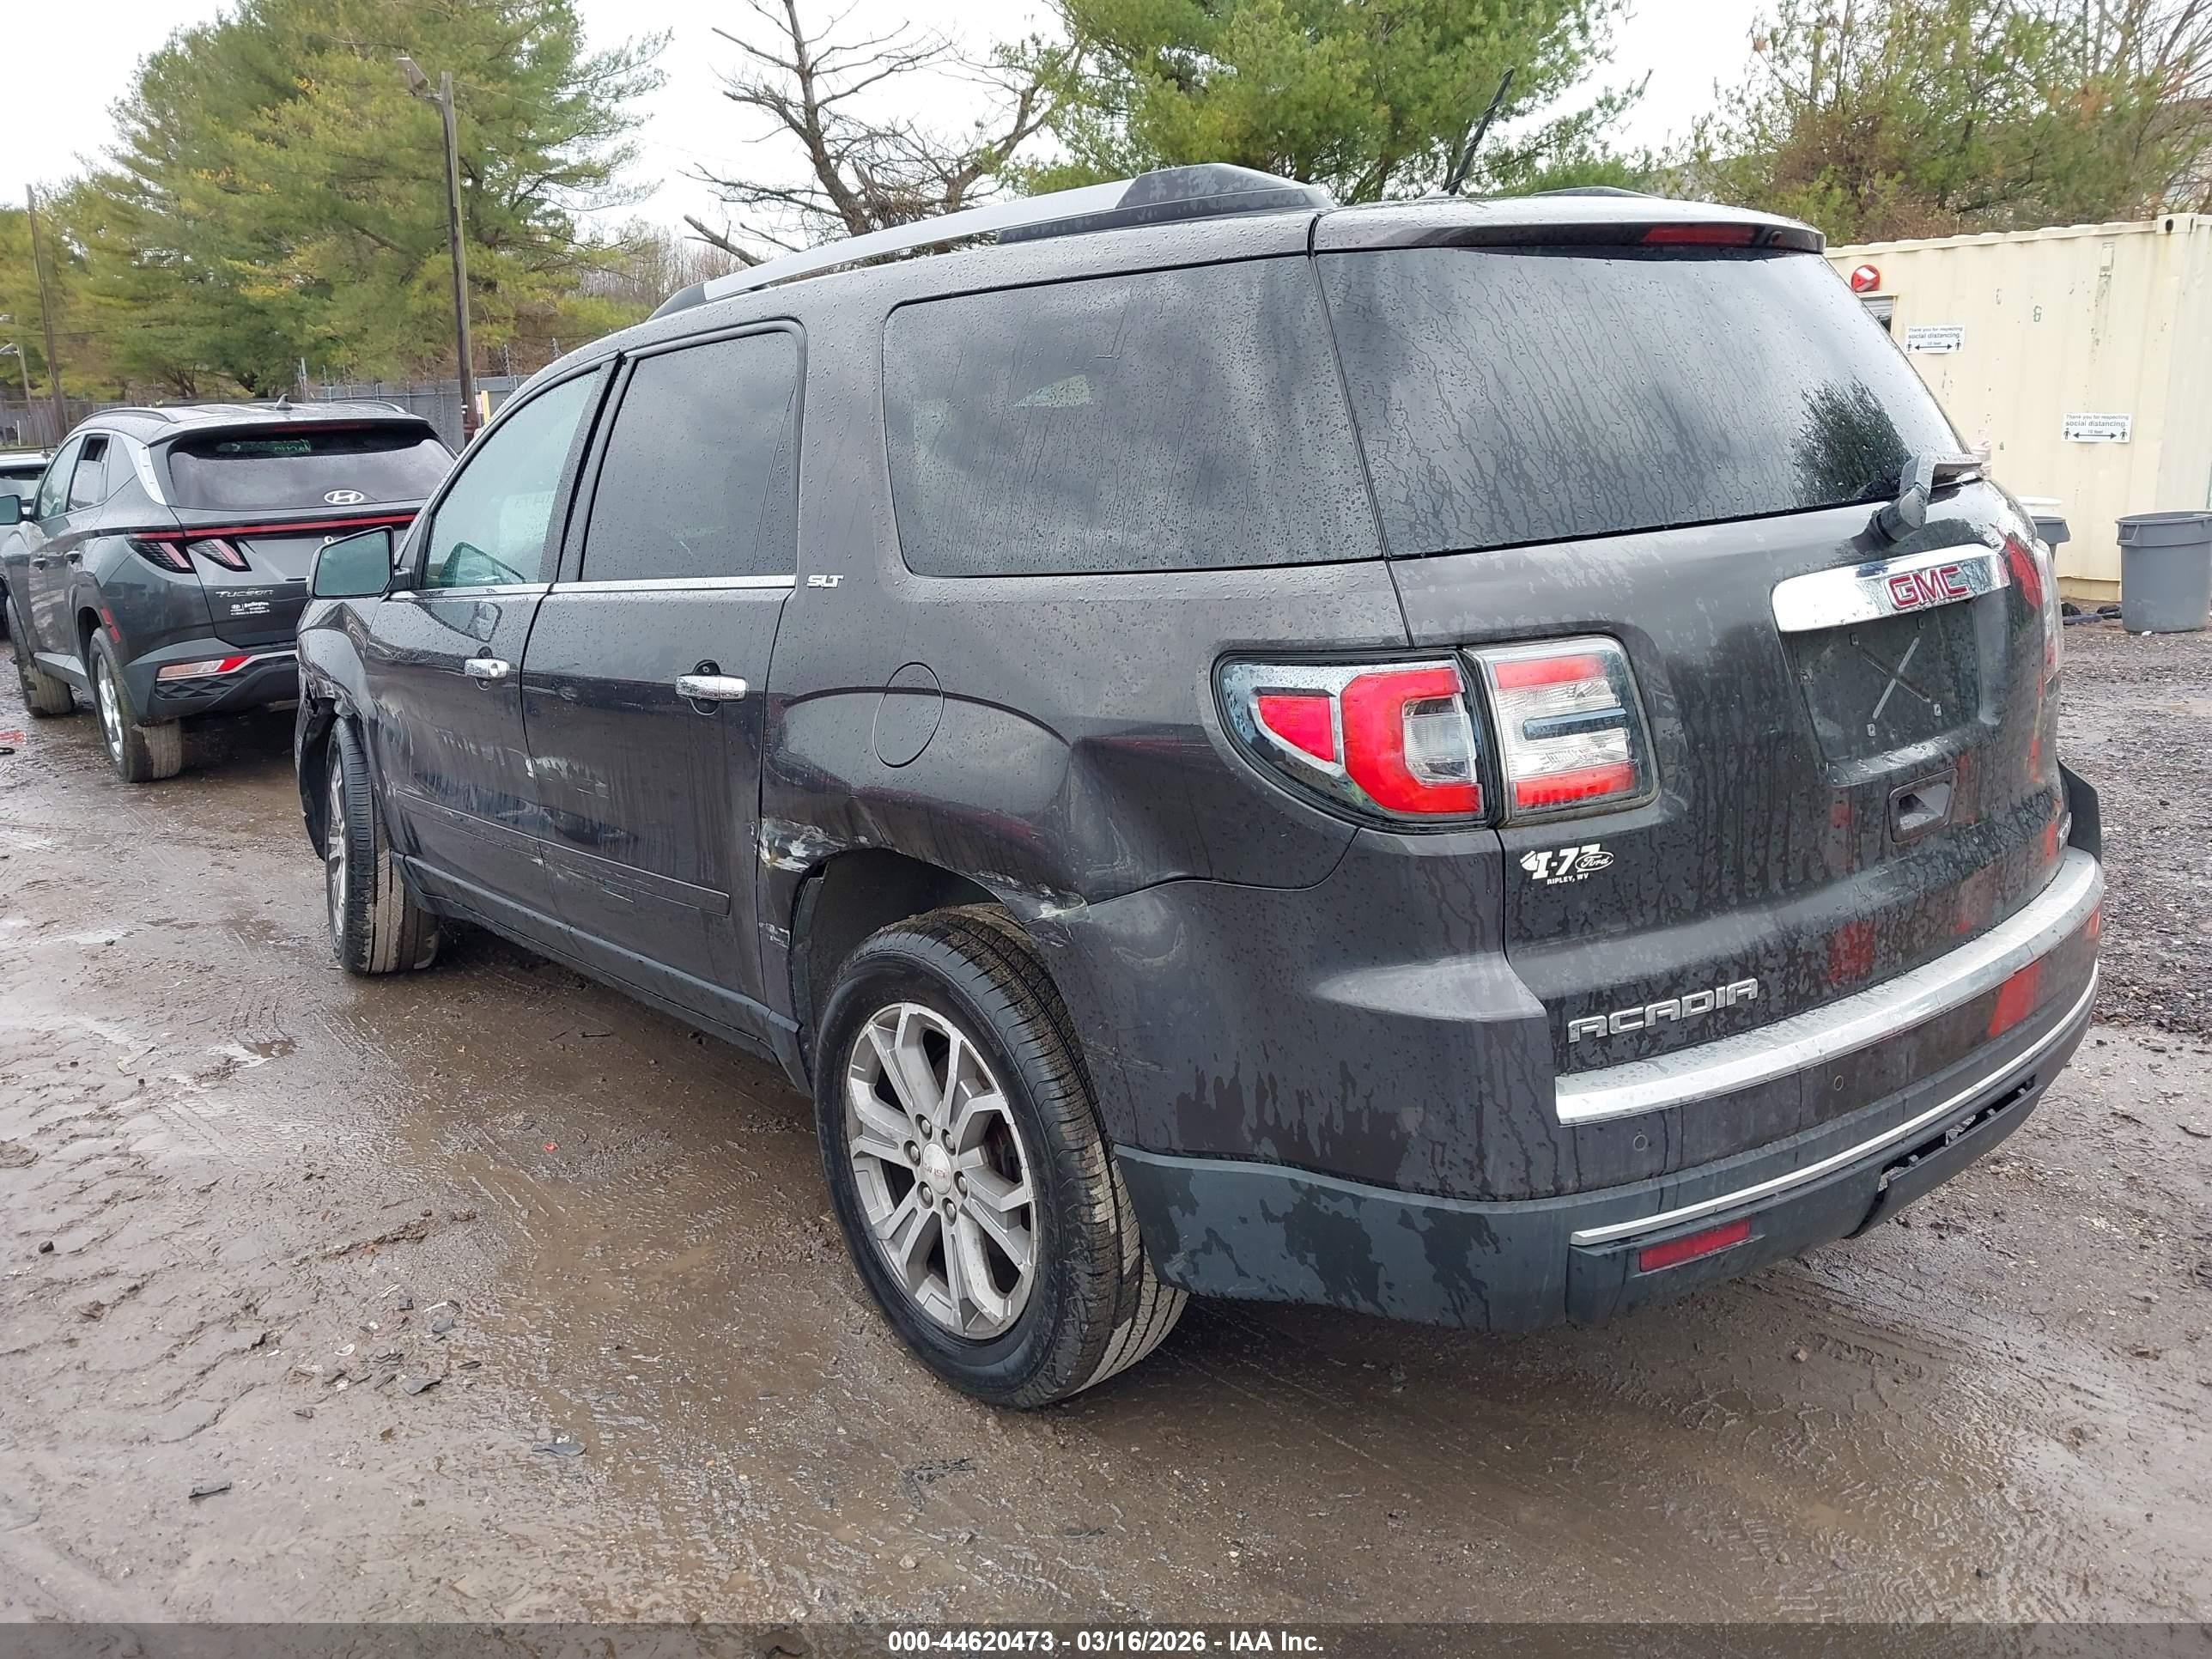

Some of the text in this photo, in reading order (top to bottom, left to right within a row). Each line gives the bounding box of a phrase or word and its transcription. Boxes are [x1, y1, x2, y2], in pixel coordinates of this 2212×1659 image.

[806, 574, 844, 588] SLT
[1887, 563, 1970, 608] GMC
[1580, 854, 1609, 868] Ford
[1547, 875, 1576, 885] RIPLEY,
[1567, 977, 1759, 1043] ACADIA
